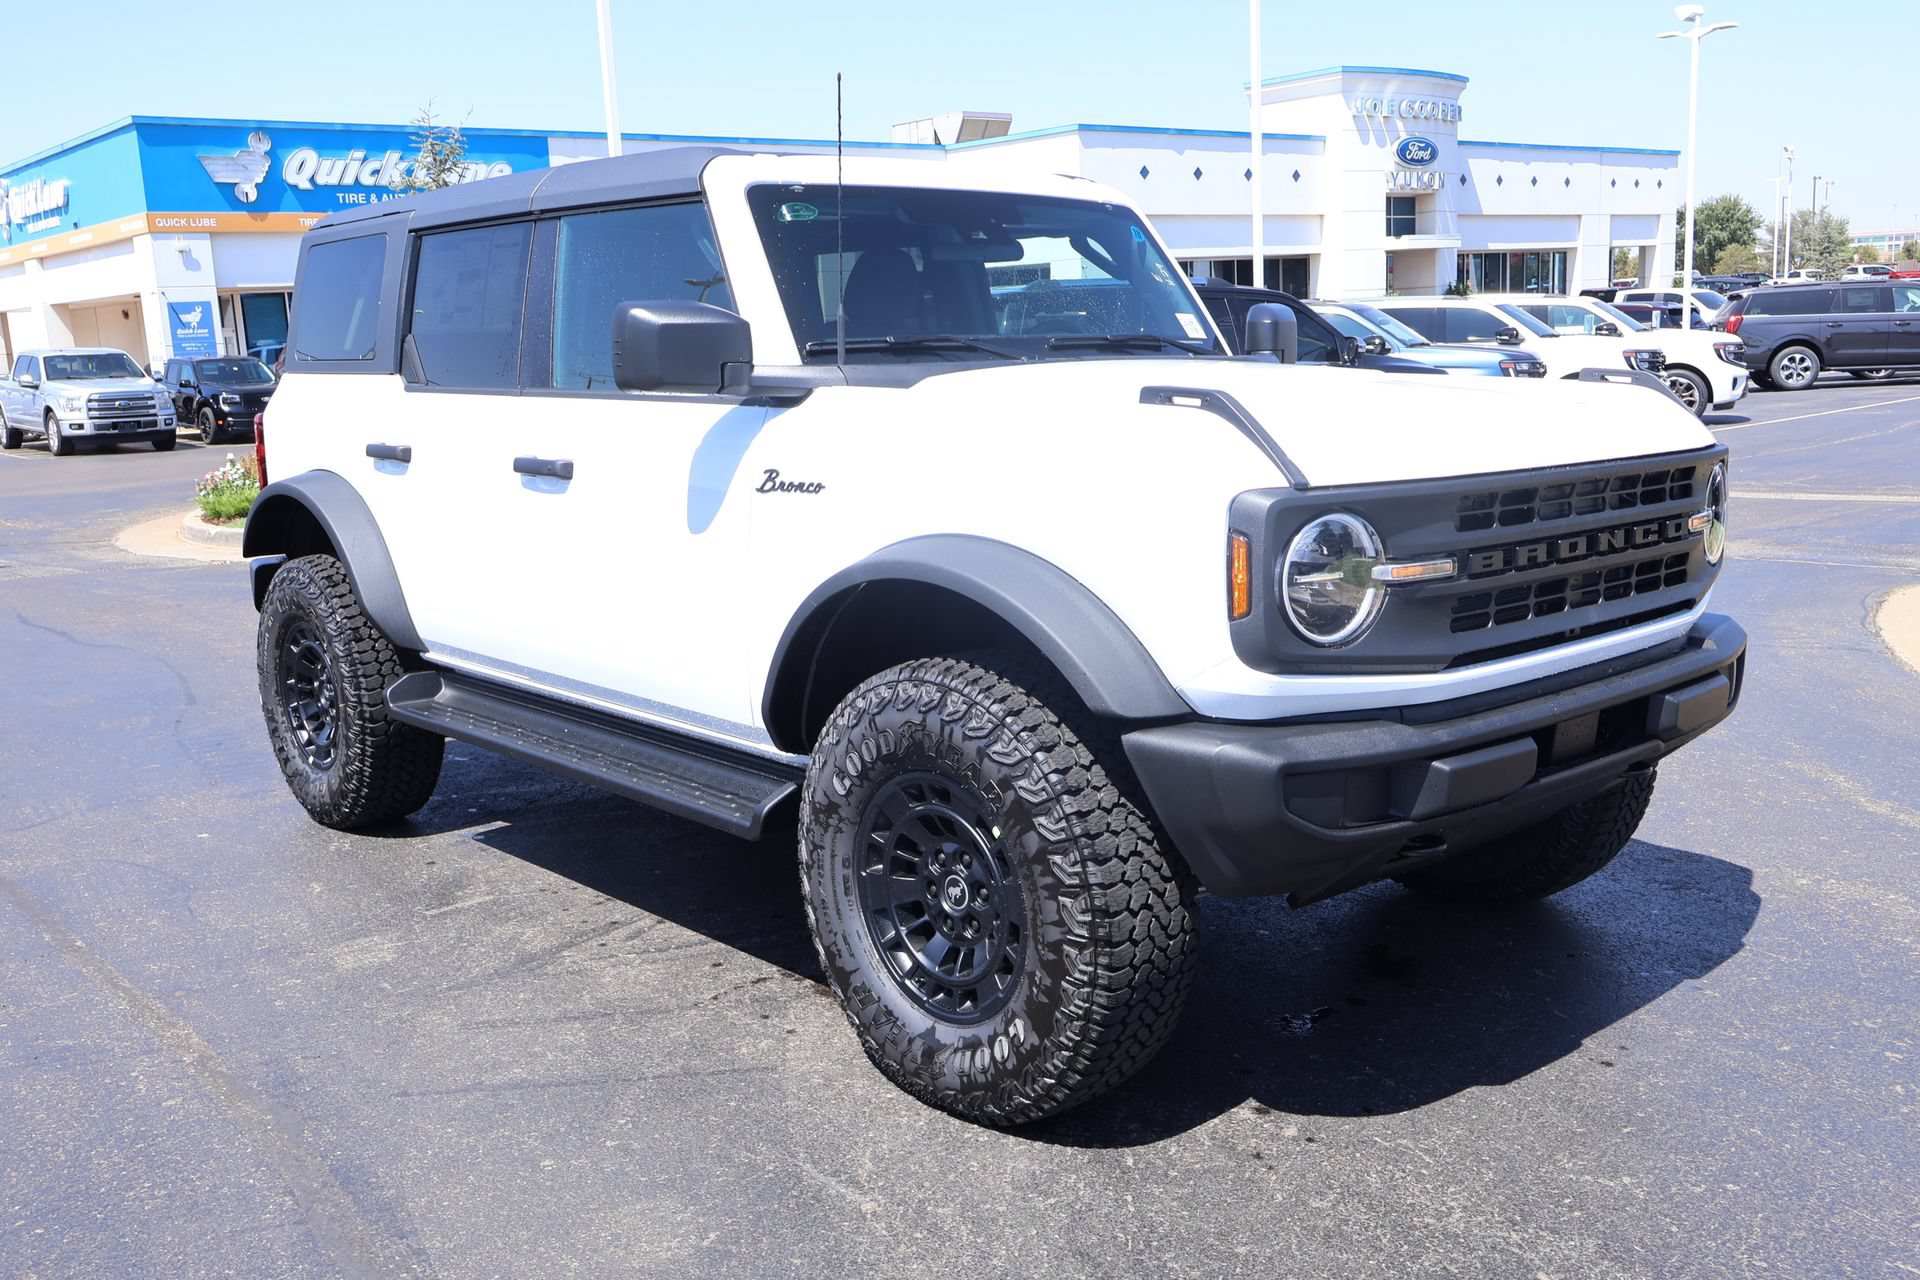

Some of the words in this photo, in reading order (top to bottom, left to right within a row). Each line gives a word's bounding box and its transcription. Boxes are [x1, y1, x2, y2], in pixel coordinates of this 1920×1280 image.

[1354, 98, 1396, 117] JOE
[1400, 99, 1462, 121] COOPER
[1405, 141, 1432, 161] Ford
[284, 148, 410, 190] Quick
[1388, 171, 1445, 189] YUKON
[336, 193, 367, 204] TIRE
[370, 193, 378, 204] &
[155, 217, 188, 227] QUICK
[190, 217, 217, 227] LUBE
[755, 469, 826, 494] Bronco
[1470, 518, 1689, 575] BRONCO
